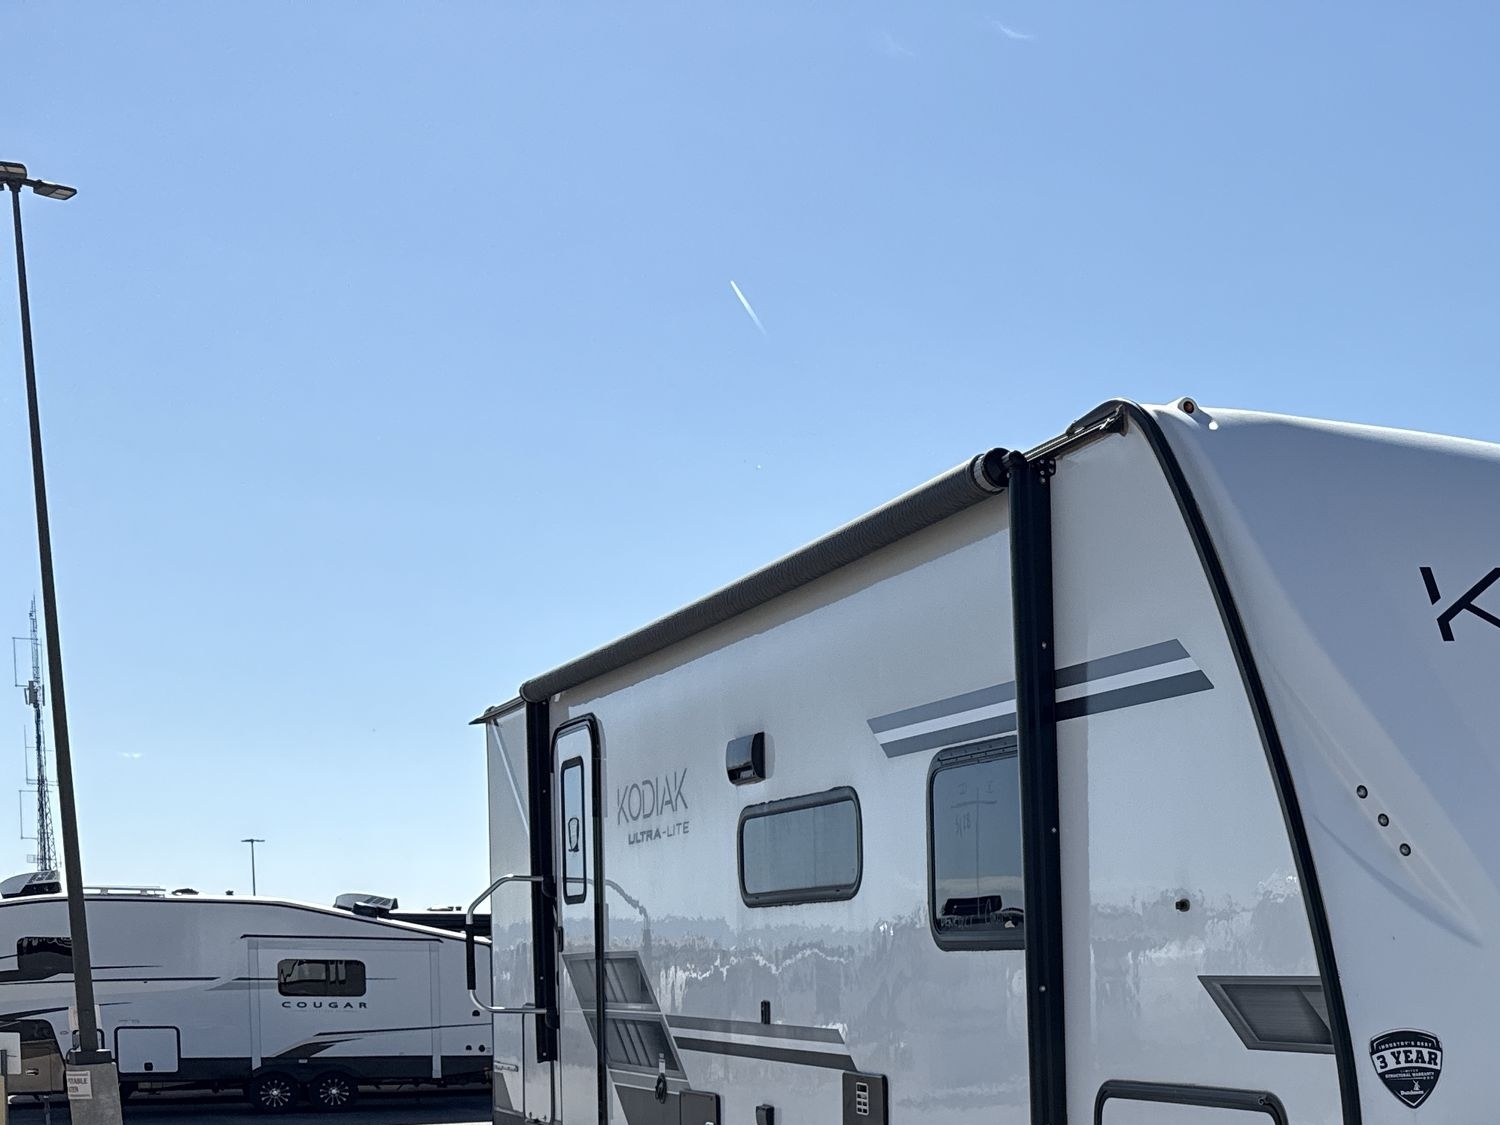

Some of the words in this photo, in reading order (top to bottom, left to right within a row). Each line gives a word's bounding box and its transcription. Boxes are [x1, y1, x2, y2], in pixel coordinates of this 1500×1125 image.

[617, 767, 688, 825] KODIAK
[628, 820, 690, 845] ULTRA-LITE
[281, 1001, 368, 1009] COUGAR
[1376, 1054, 1388, 1070] 3
[1390, 1049, 1438, 1066] YEAR
